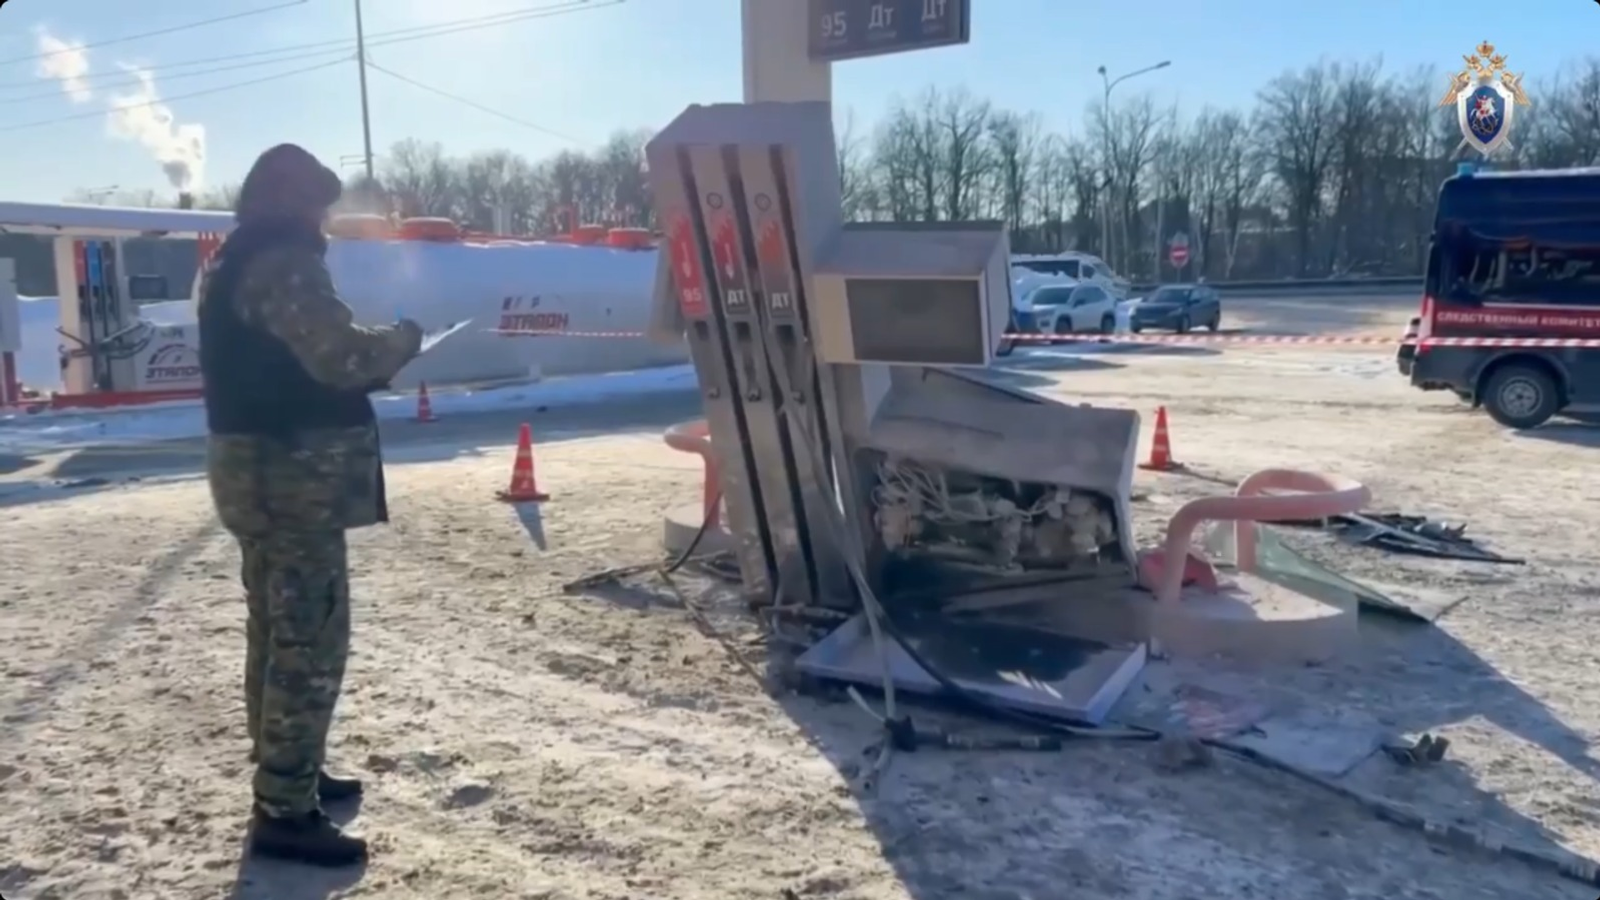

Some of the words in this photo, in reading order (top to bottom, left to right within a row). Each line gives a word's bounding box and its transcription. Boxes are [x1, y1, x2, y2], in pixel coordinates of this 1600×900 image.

[821, 11, 847, 37] 95
[683, 288, 702, 303] 95
[1437, 312, 1538, 325] СЛЕДСТВЕННЫЙ
